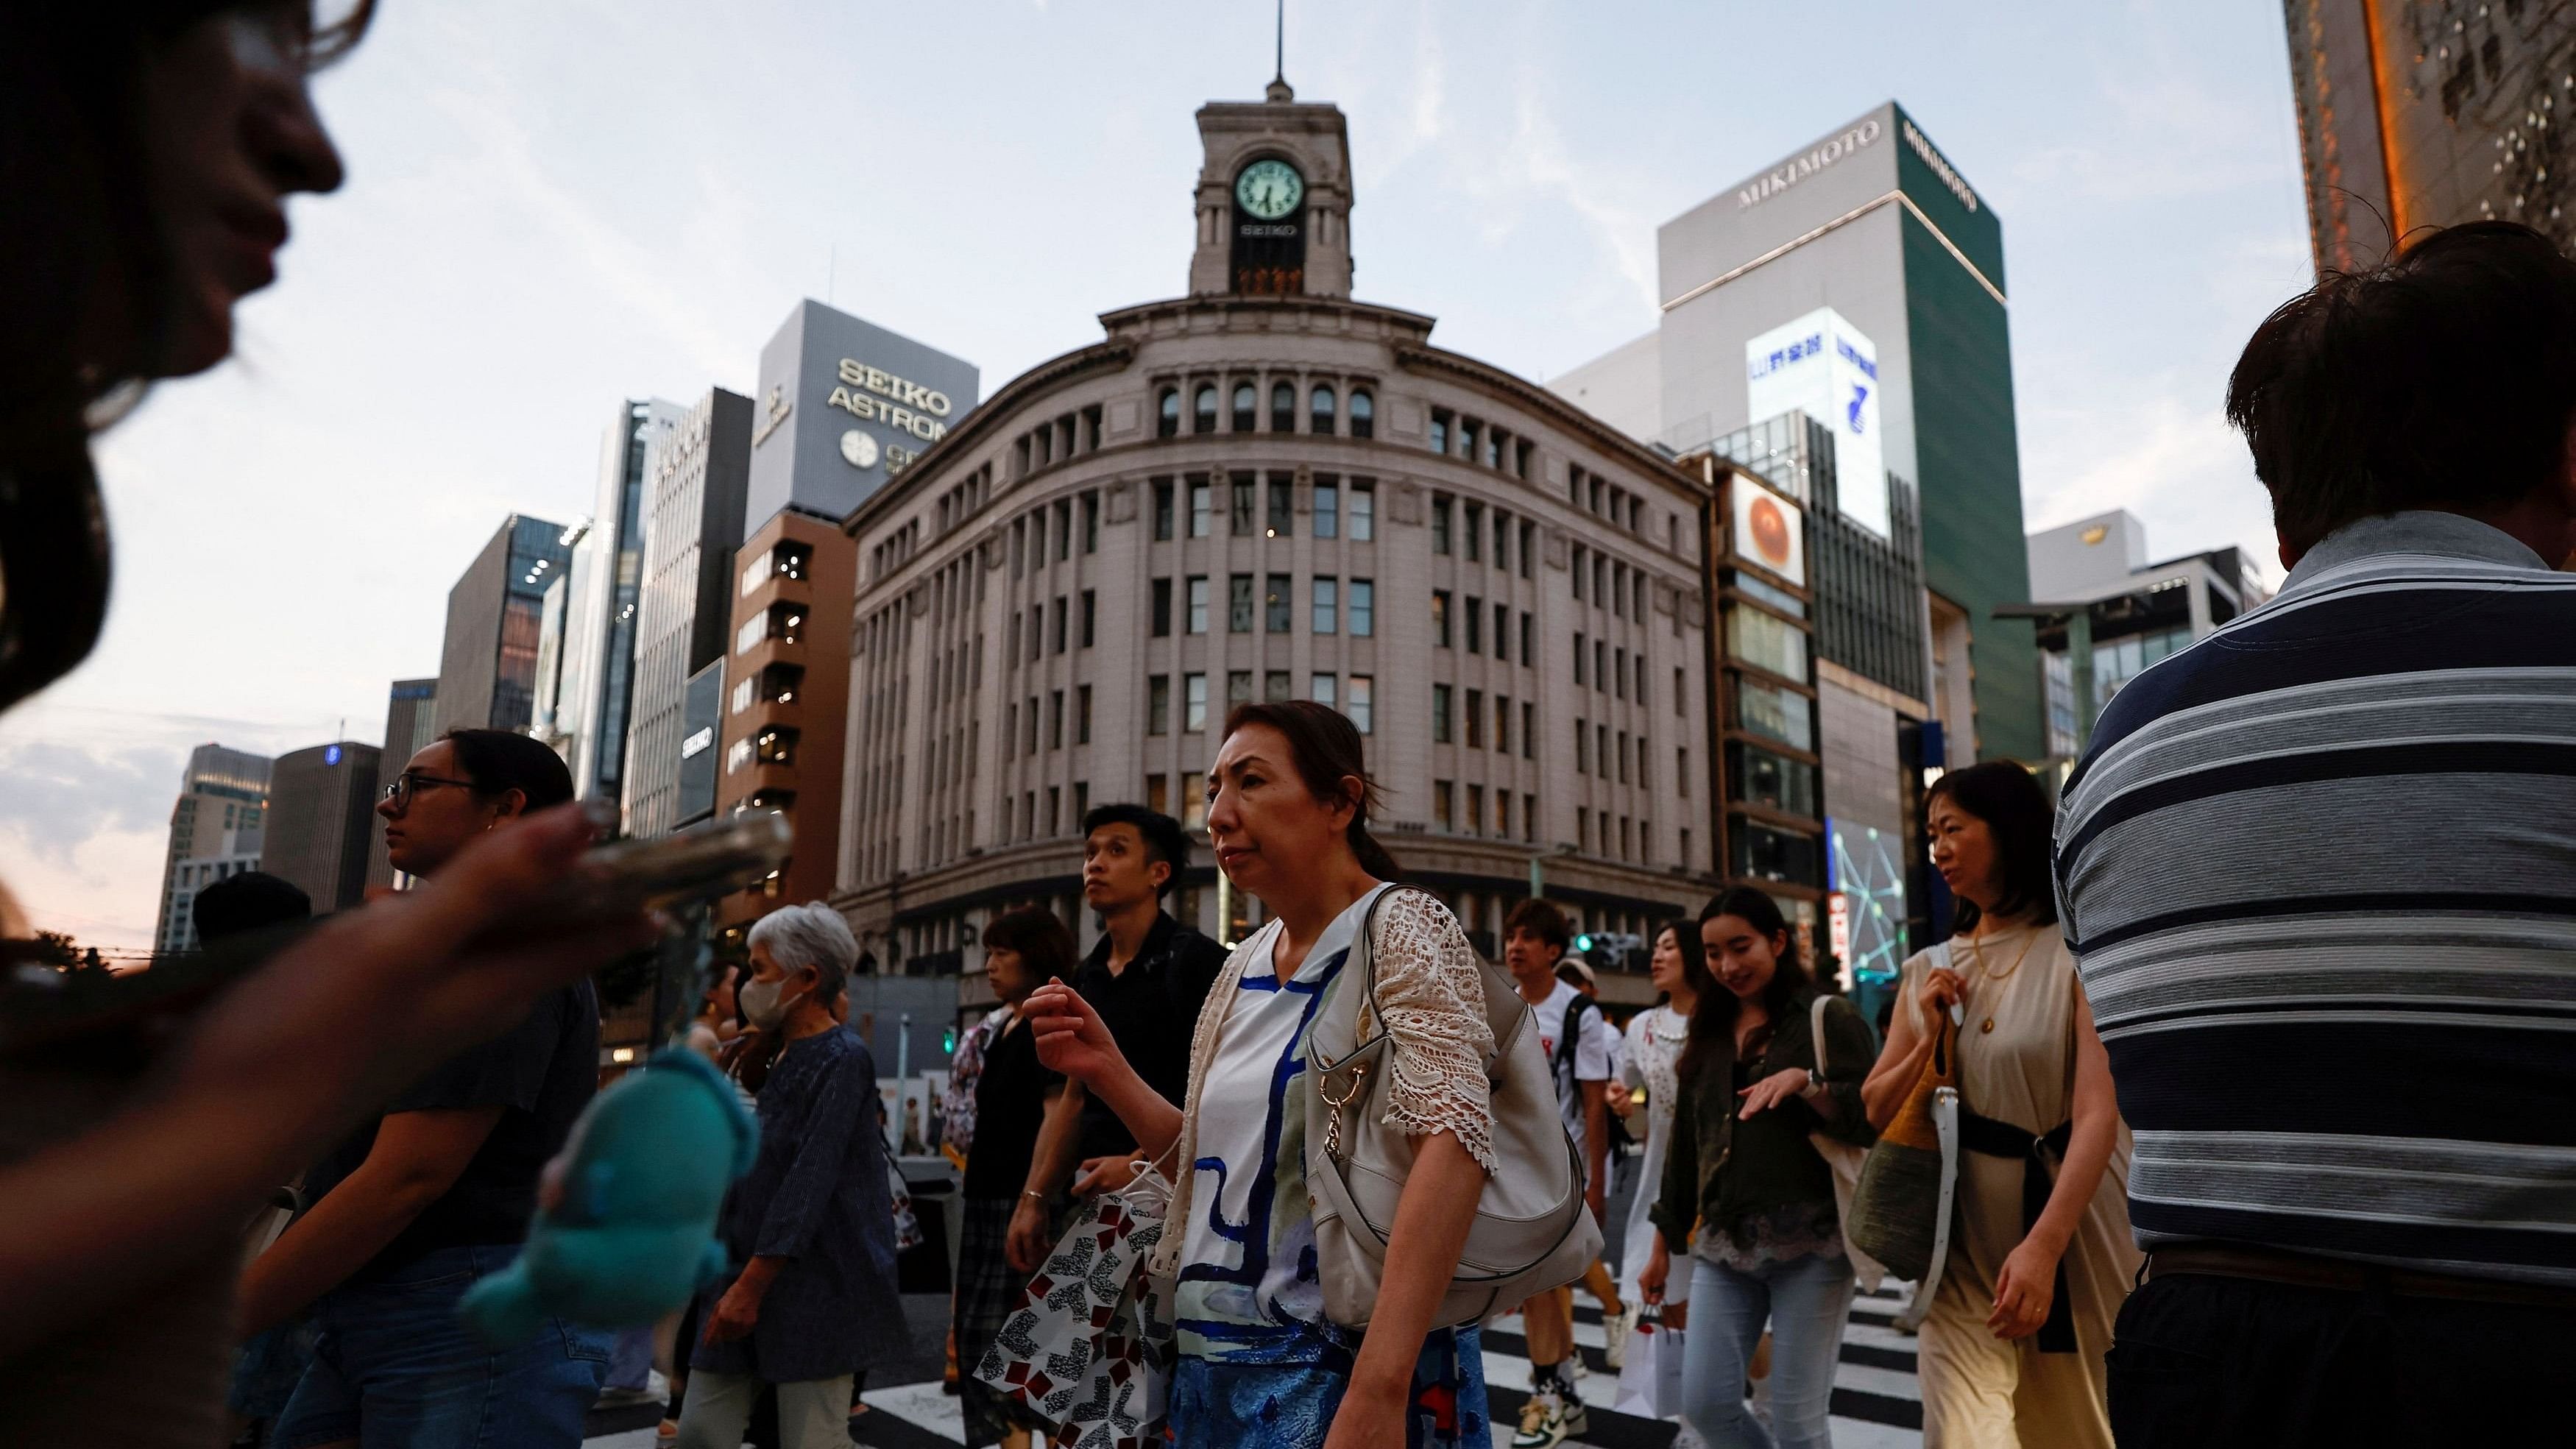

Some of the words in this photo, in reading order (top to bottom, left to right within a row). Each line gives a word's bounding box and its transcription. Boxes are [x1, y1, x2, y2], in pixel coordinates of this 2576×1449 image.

[1738, 120, 1880, 210] MIKIMOTO
[1240, 224, 1297, 236] SEIKO
[839, 357, 952, 417] SEIKO
